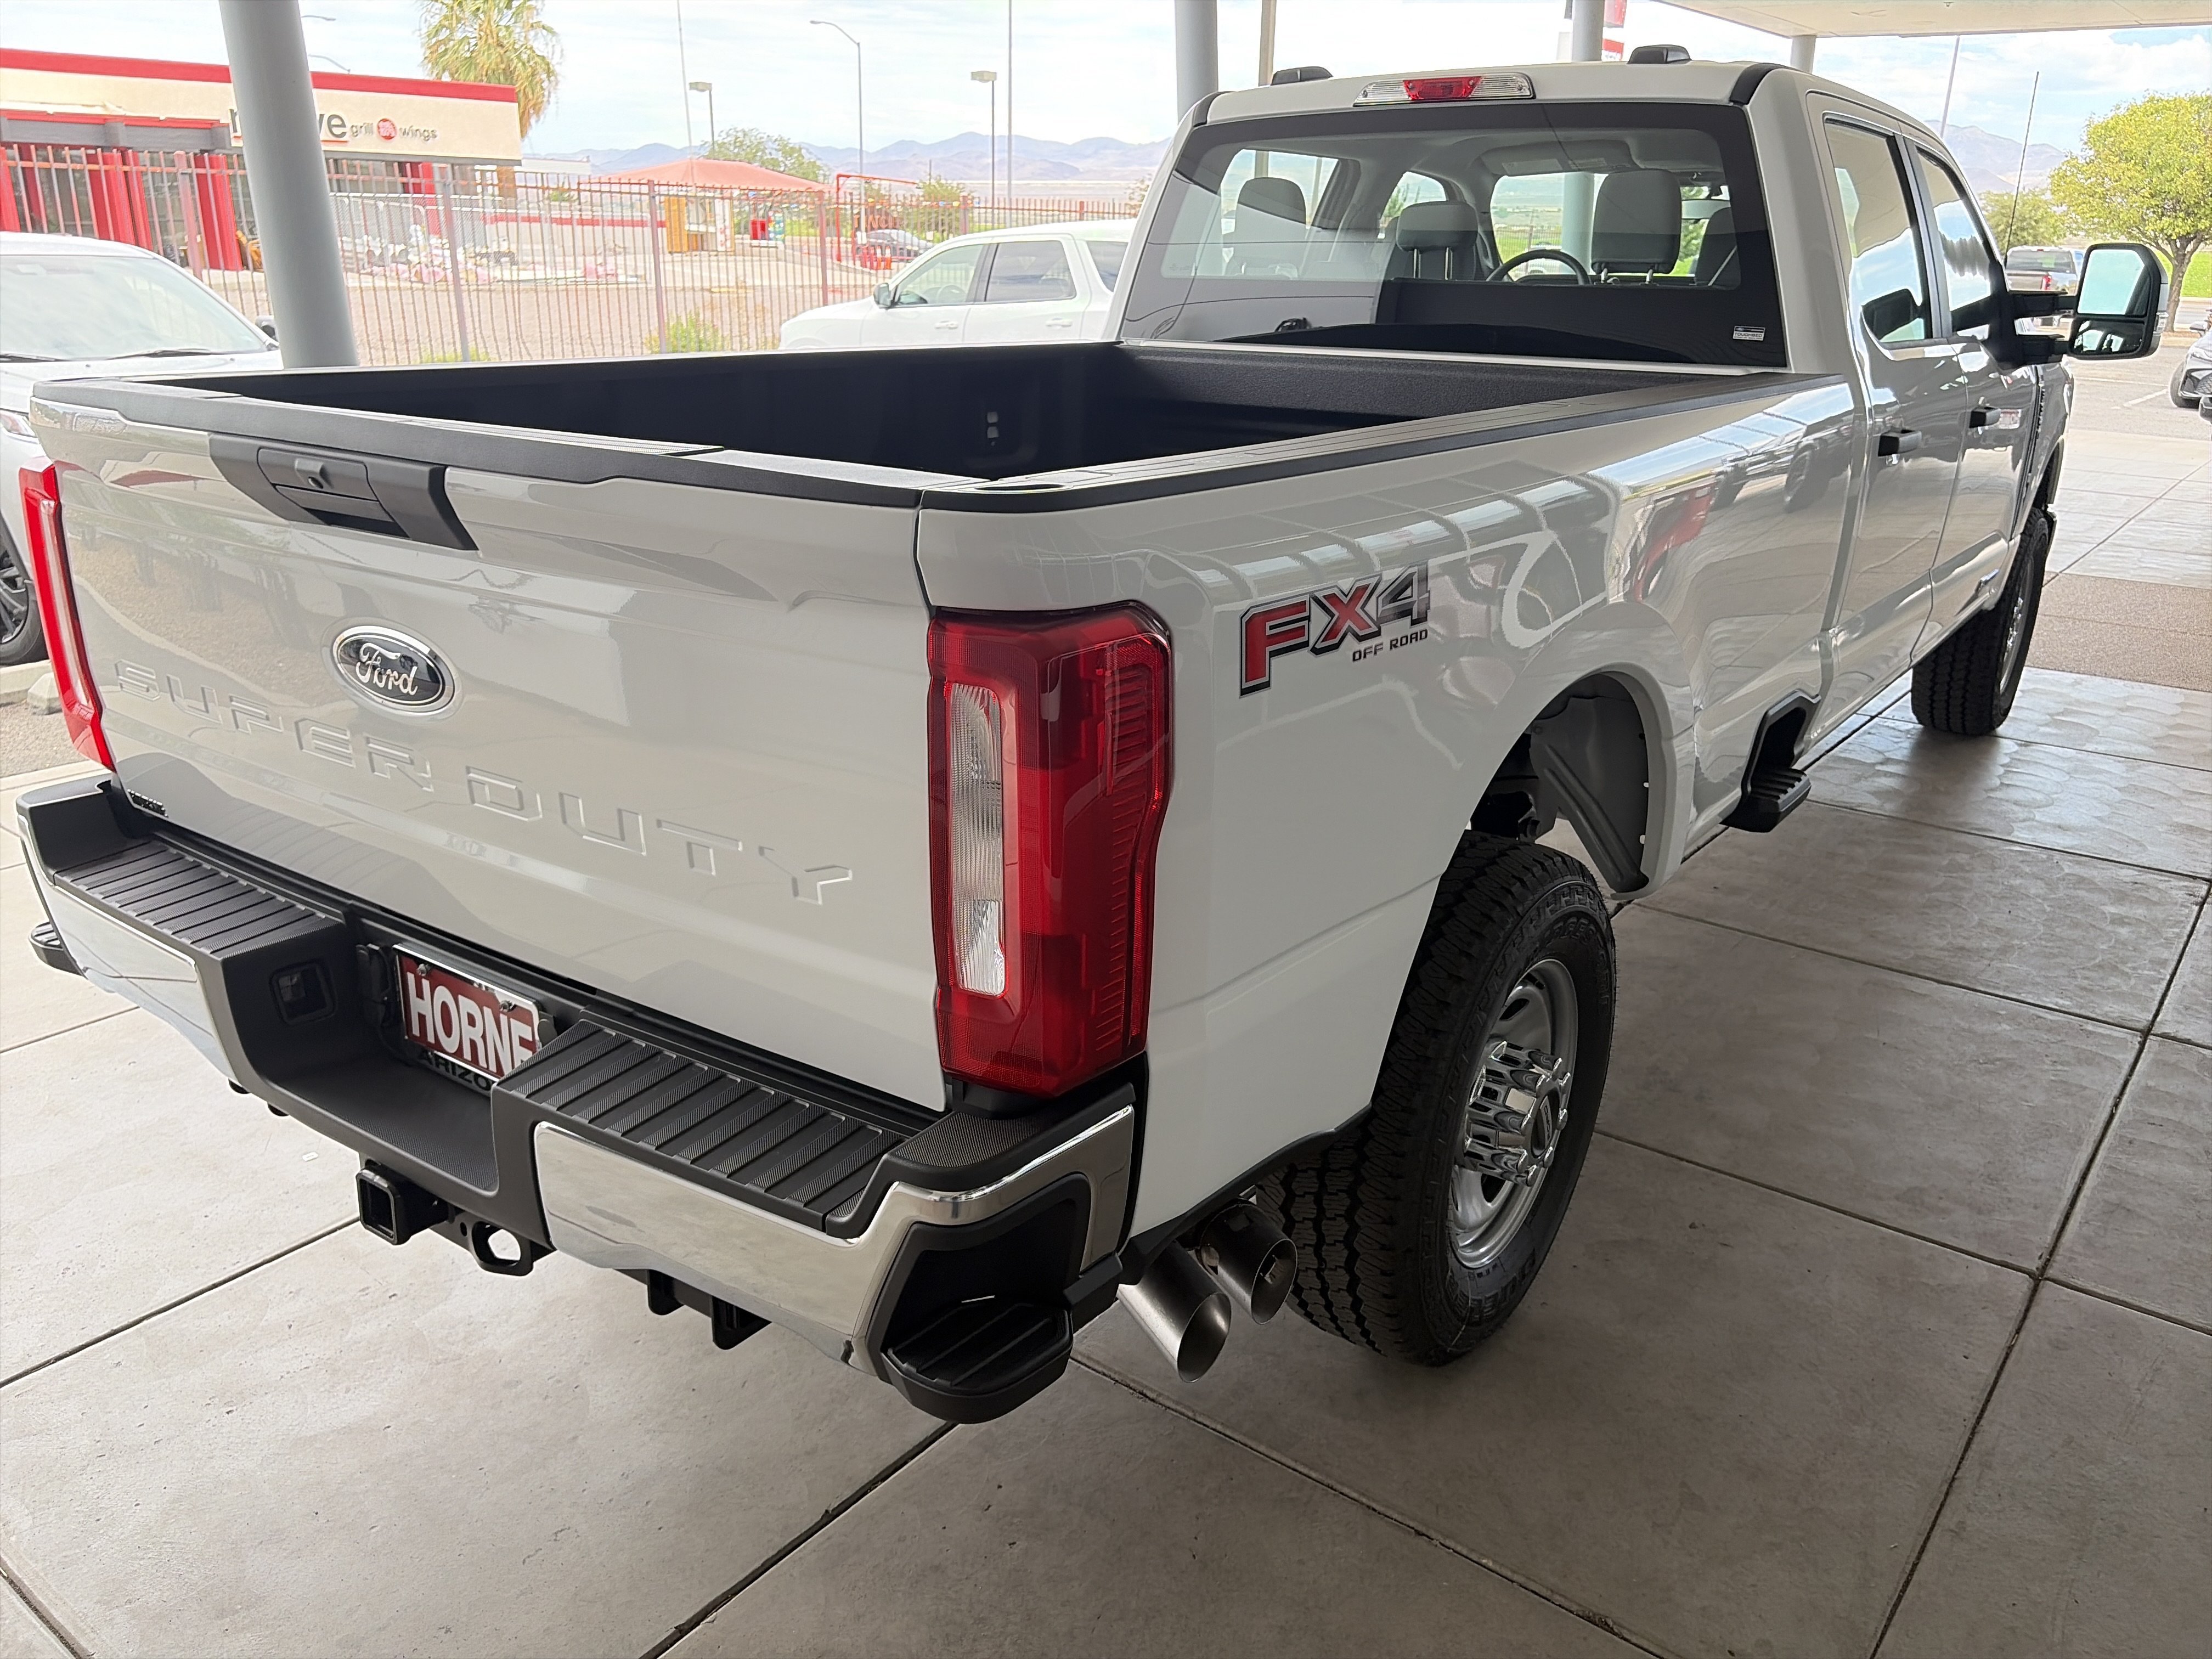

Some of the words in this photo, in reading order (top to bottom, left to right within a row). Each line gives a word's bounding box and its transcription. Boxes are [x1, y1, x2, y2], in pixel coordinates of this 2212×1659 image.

[399, 126, 438, 142] wings
[355, 642, 419, 696] Ford
[1239, 560, 1430, 698] FX4
[1352, 642, 1384, 663] OFF
[1389, 629, 1428, 651] ROAD
[115, 658, 435, 793] SUPER
[466, 765, 853, 905] DUTY
[407, 971, 534, 1077] HORNE
